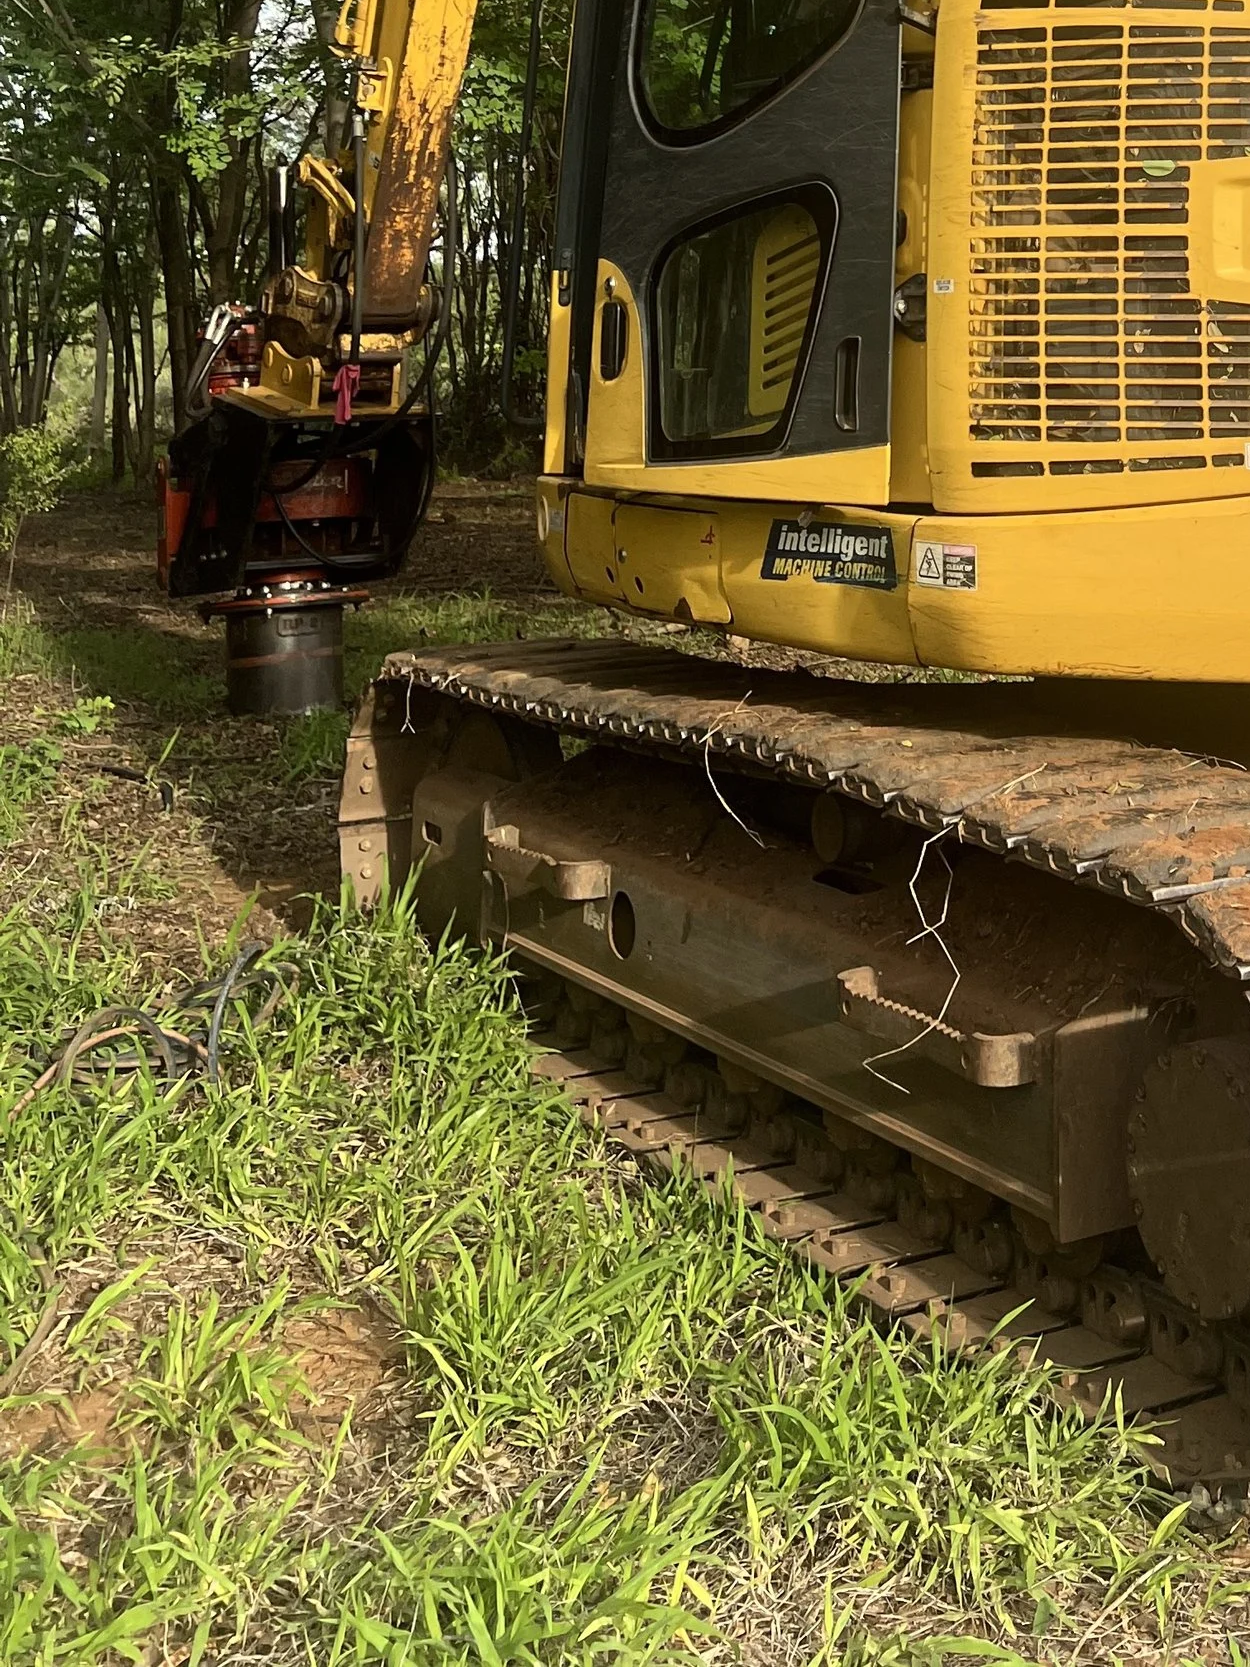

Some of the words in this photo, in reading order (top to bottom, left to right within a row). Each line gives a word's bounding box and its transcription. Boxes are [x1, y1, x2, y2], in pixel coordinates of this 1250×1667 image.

[777, 524, 889, 562] intelligent
[772, 557, 832, 578] MACHINE
[836, 563, 887, 583] CONTROL
